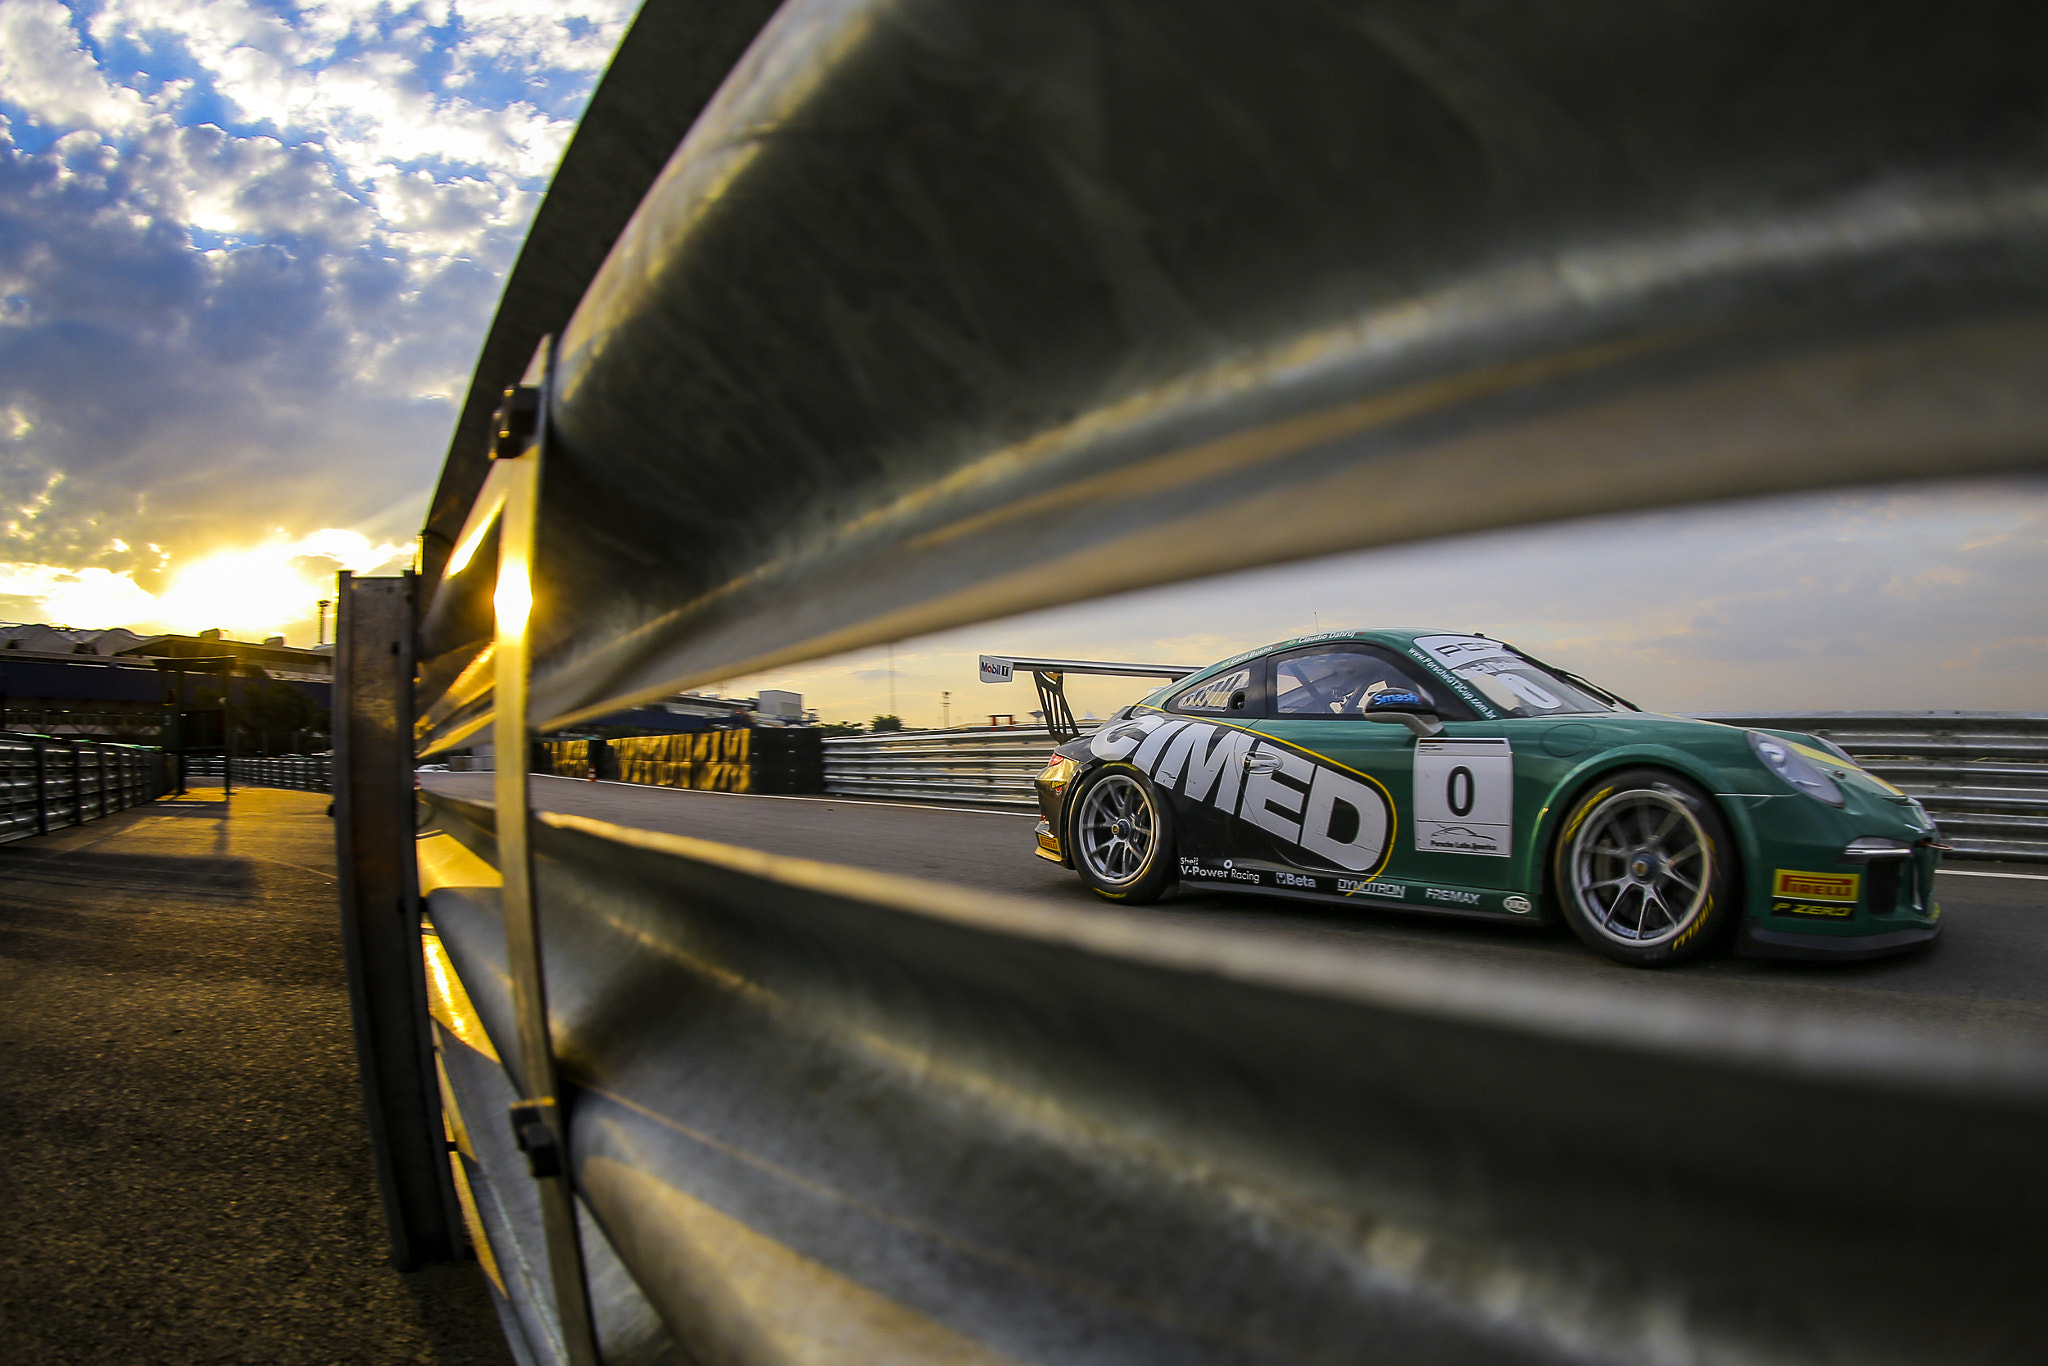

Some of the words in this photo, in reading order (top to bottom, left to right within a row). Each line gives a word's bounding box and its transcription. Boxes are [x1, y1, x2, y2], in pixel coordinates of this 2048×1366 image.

[981, 661, 1000, 675] Mobil
[1090, 715, 1388, 872] CIMED
[1446, 766, 1475, 817] 0
[1180, 865, 1229, 878] V-Power
[1231, 869, 1260, 884] Racing
[1286, 873, 1316, 888] Beta
[1781, 874, 1852, 896] PIRELLI
[1425, 888, 1480, 905] FREMAX
[1773, 902, 1791, 911] P
[1791, 904, 1853, 917] ZERO
